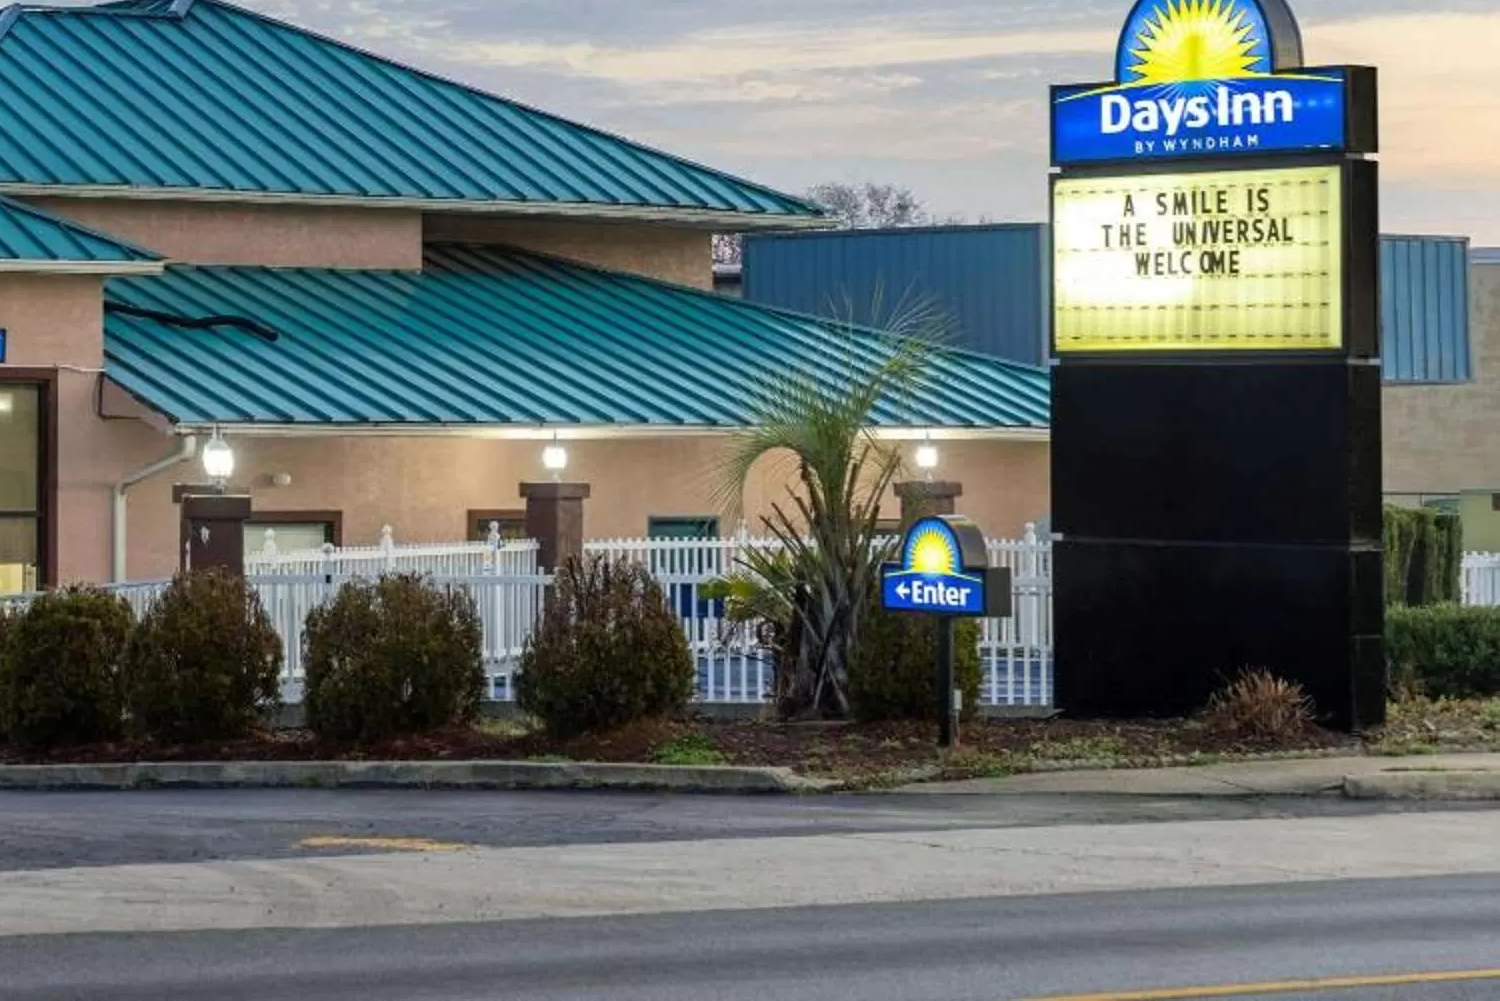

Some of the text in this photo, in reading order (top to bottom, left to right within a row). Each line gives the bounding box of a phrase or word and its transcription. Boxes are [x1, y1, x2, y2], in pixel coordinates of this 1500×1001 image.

[1134, 134, 1259, 154] BY WYNDHAM
[1123, 188, 1270, 217] A SMILE IS
[1101, 217, 1294, 248] THE UNIVERSAL
[1134, 250, 1241, 276] WELCOME
[911, 580, 972, 607] Enter
